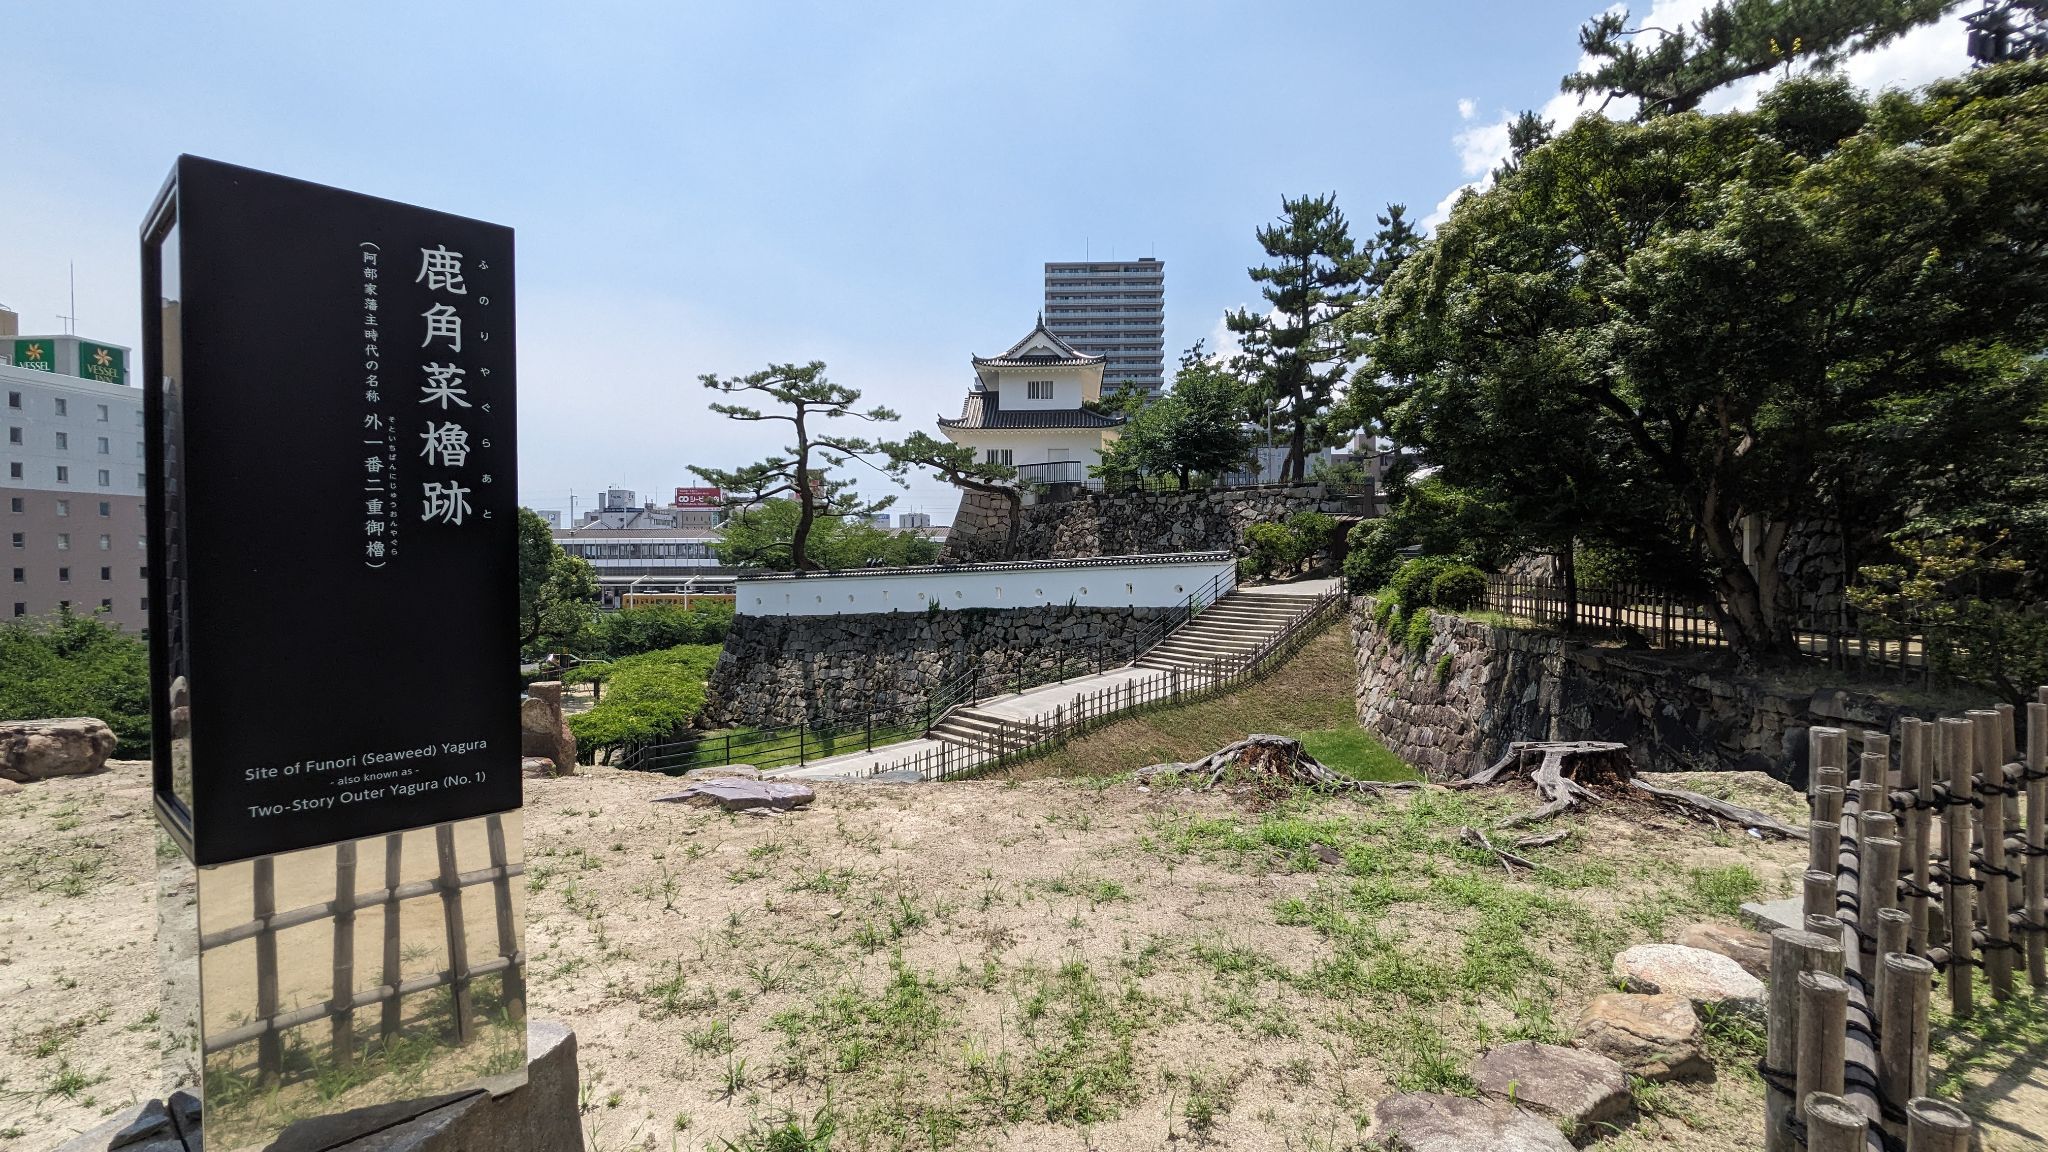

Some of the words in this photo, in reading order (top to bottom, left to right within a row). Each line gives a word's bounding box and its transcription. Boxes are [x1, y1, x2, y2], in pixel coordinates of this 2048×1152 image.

[87, 363, 120, 378] VESSEL
[415, 244, 473, 526] 鹿角菜櫓跡
[478, 260, 492, 519] ふのりやぐらあと
[245, 767, 278, 781] Site
[283, 763, 301, 777] of
[305, 755, 357, 773] Funori
[362, 745, 437, 767] (Seaweed)
[441, 739, 488, 755] Yagura
[337, 775, 361, 786] also
[363, 769, 399, 784] known
[401, 768, 413, 778] as
[248, 795, 335, 818] Two-Story
[340, 787, 385, 804] Outer
[390, 779, 439, 796] Yagura
[443, 774, 472, 789] (No.
[475, 771, 486, 784] 1)
